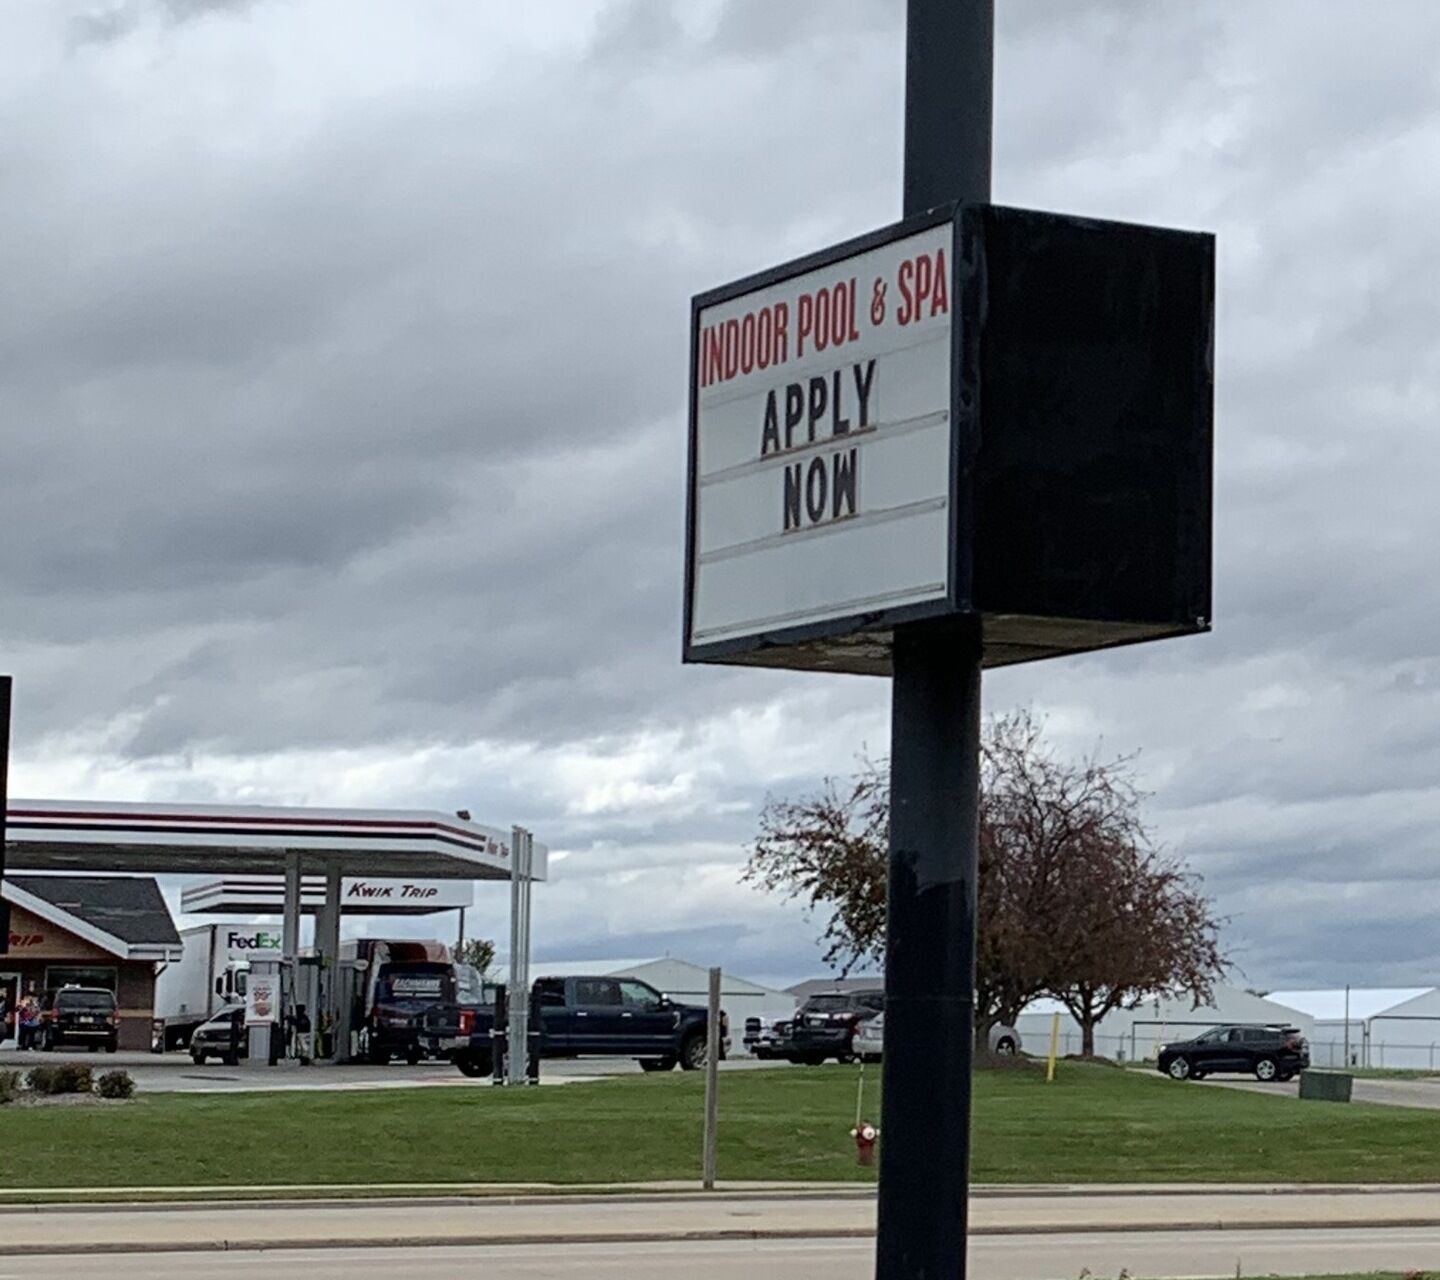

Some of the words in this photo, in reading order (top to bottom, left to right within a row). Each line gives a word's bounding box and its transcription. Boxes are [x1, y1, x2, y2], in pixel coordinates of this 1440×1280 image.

[701, 302, 788, 388] INDOOR
[798, 276, 859, 358] POOL
[870, 276, 887, 327] &
[896, 248, 948, 326] SPA
[761, 359, 877, 455] APPLY
[783, 448, 857, 531] NOW
[227, 931, 281, 949] FedEx
